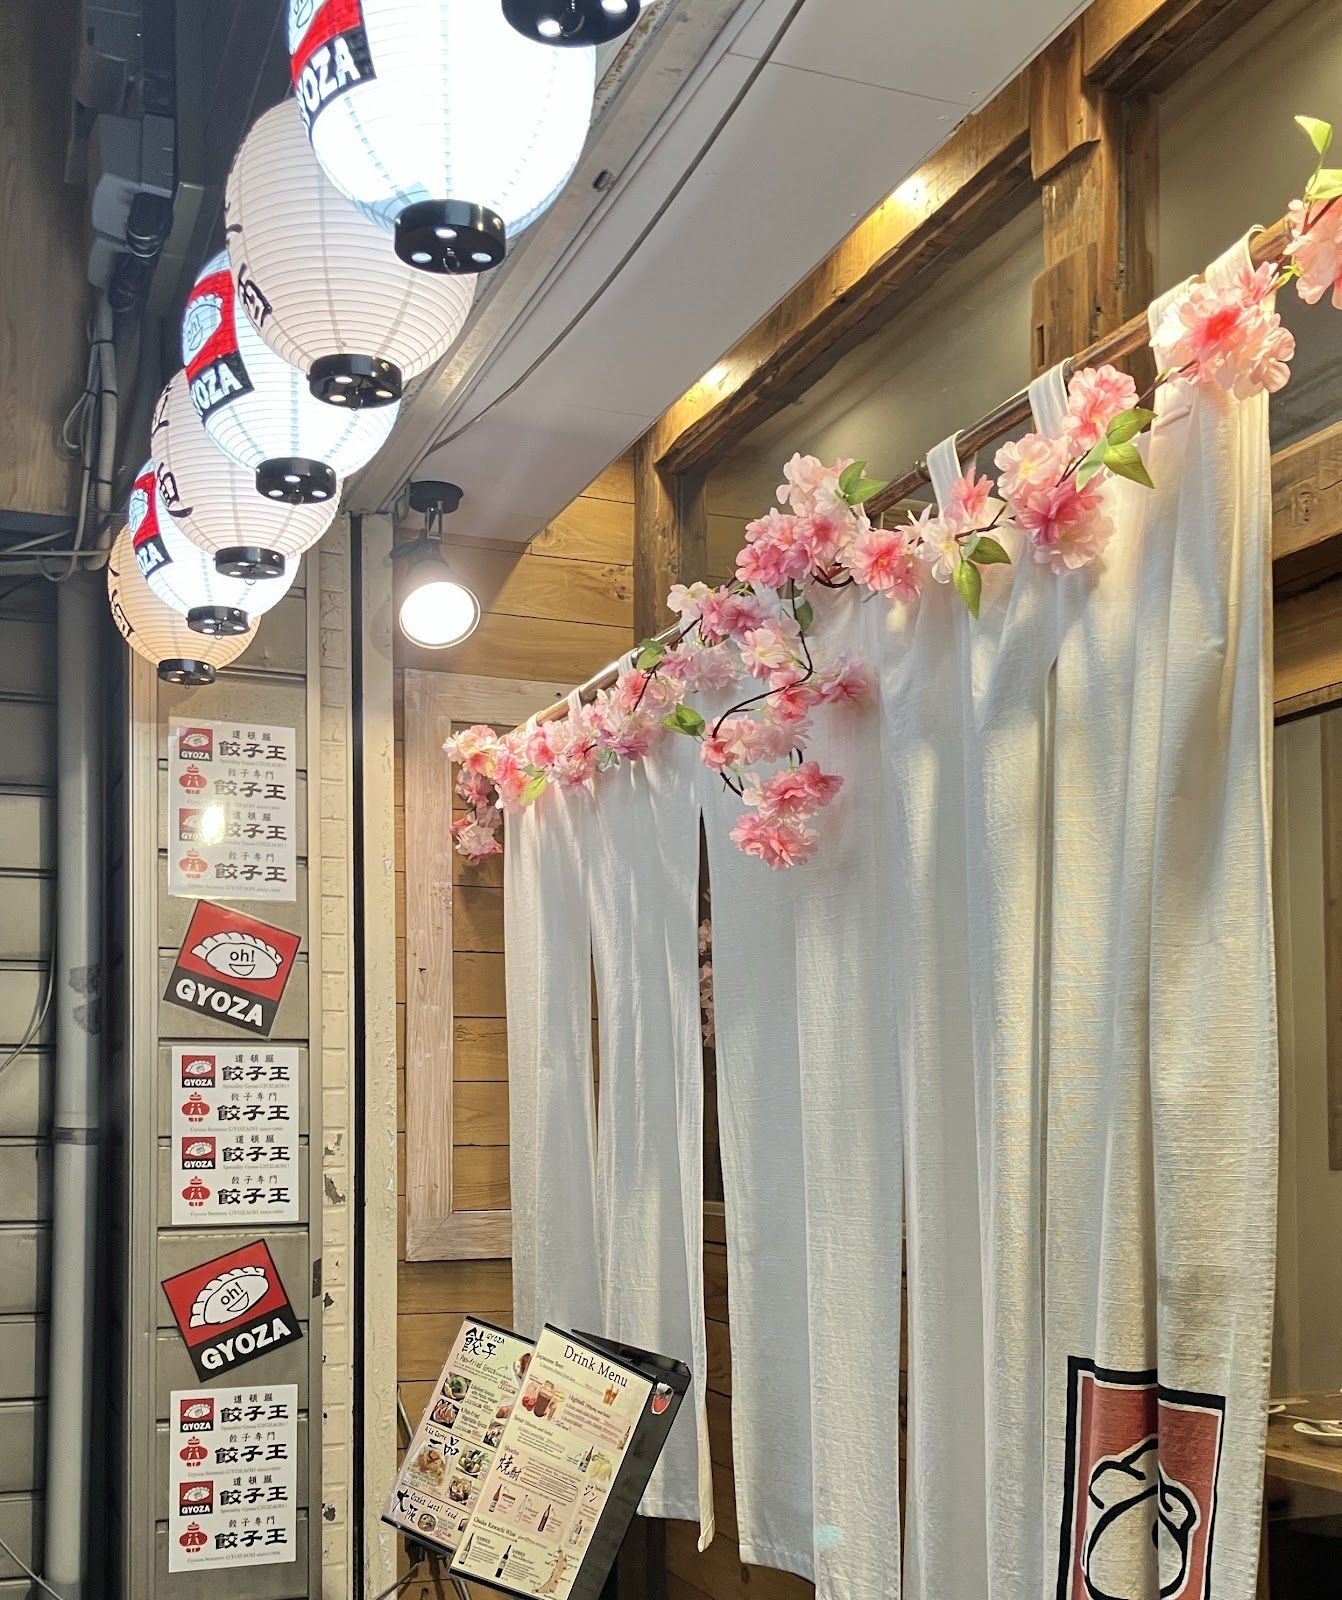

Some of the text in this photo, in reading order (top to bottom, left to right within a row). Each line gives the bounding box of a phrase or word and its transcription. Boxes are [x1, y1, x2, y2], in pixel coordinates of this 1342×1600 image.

[296, 36, 361, 126] OZA
[191, 362, 243, 416] OZA
[181, 751, 210, 760] GYOZA
[219, 741, 287, 760] 餃子王
[214, 780, 287, 800] 餃子王
[214, 863, 287, 882] 餃子王
[230, 949, 254, 962] oh!
[176, 979, 263, 1027] GYOZA
[221, 1065, 290, 1081] 餃子王
[183, 1079, 213, 1087] GYOZA
[217, 1104, 290, 1121] 餃子王
[222, 1146, 291, 1162] 餃子王
[183, 1160, 213, 1168] GYOZA
[217, 1187, 290, 1205] 餃子王
[221, 1282, 244, 1305] oh!
[200, 1317, 291, 1370] GYOZA
[462, 1327, 496, 1359] 餃子
[563, 1345, 596, 1371] Drink
[597, 1362, 628, 1388] Menu
[220, 1404, 288, 1423] 餃子王
[182, 1422, 211, 1431] GYOZA
[215, 1443, 288, 1464] 餃子王
[496, 1454, 522, 1481] 焼酎
[219, 1486, 288, 1505] 餃子王
[181, 1505, 211, 1514] GYOZA
[214, 1528, 288, 1549] 餃子王
